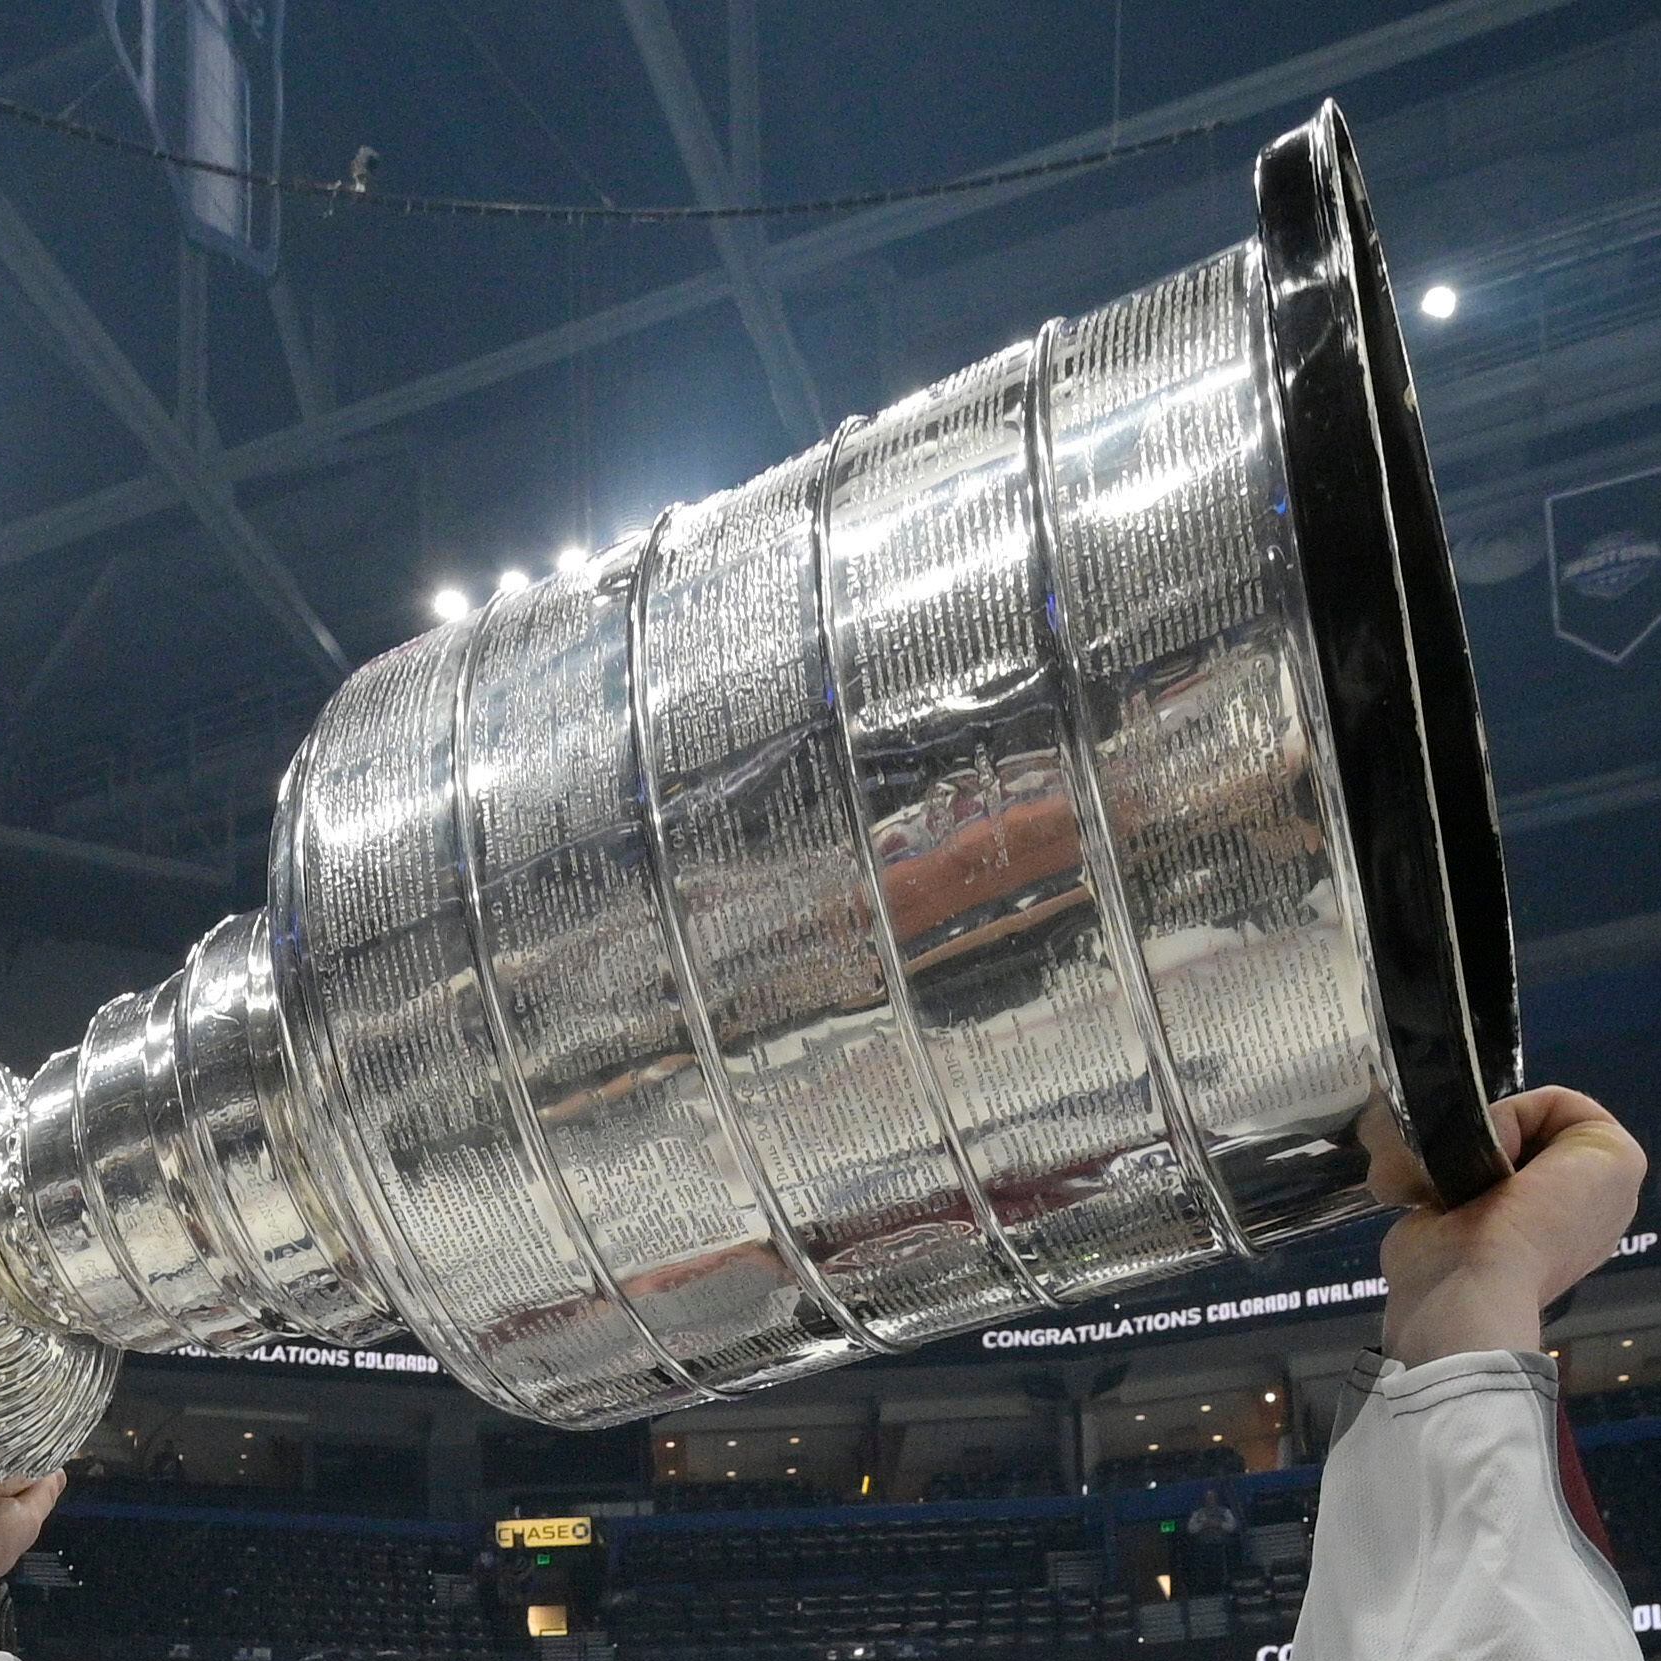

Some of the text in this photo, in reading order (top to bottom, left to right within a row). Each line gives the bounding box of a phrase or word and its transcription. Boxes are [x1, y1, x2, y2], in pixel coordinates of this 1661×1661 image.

[1612, 1230, 1657, 1257] UP
[982, 1277, 1389, 1350] CONGRATULATIONS COLORADO AVALANC
[355, 1351, 438, 1373] COLORADO
